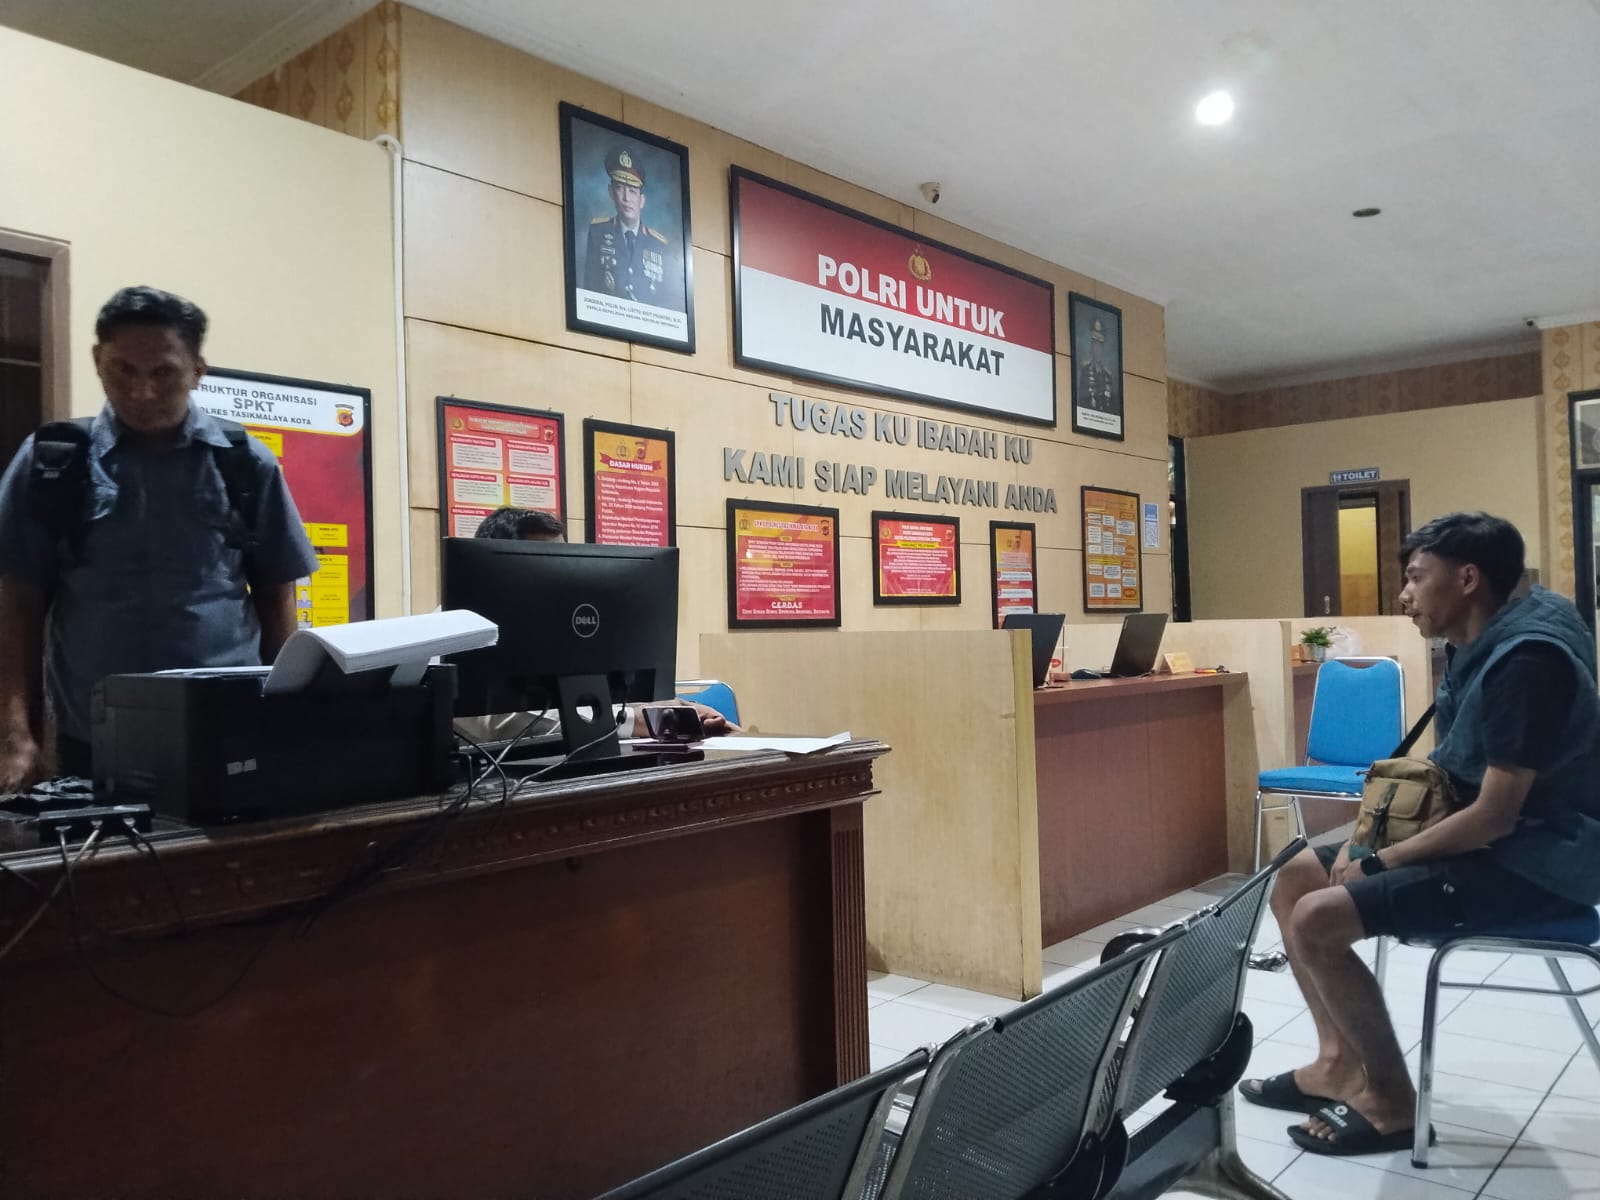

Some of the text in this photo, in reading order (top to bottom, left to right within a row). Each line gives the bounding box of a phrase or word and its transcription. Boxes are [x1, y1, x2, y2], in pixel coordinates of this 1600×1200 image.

[818, 254, 1006, 337] POLRI UNTUK
[820, 303, 1005, 376] MASYARAKAT
[201, 384, 317, 406] RUKTUR ORGANISASI
[233, 397, 275, 412] SPKT
[230, 410, 288, 423] TASIKMALAYA
[290, 417, 312, 425] KOTA
[769, 392, 1033, 464] TUGAS KU IBADAH KU
[609, 460, 653, 471] DASAR HUKUM
[723, 446, 1058, 514] KAMI SIAP MELAYANI ANDA
[1342, 471, 1376, 480] TOILET
[575, 616, 597, 625] DELL
